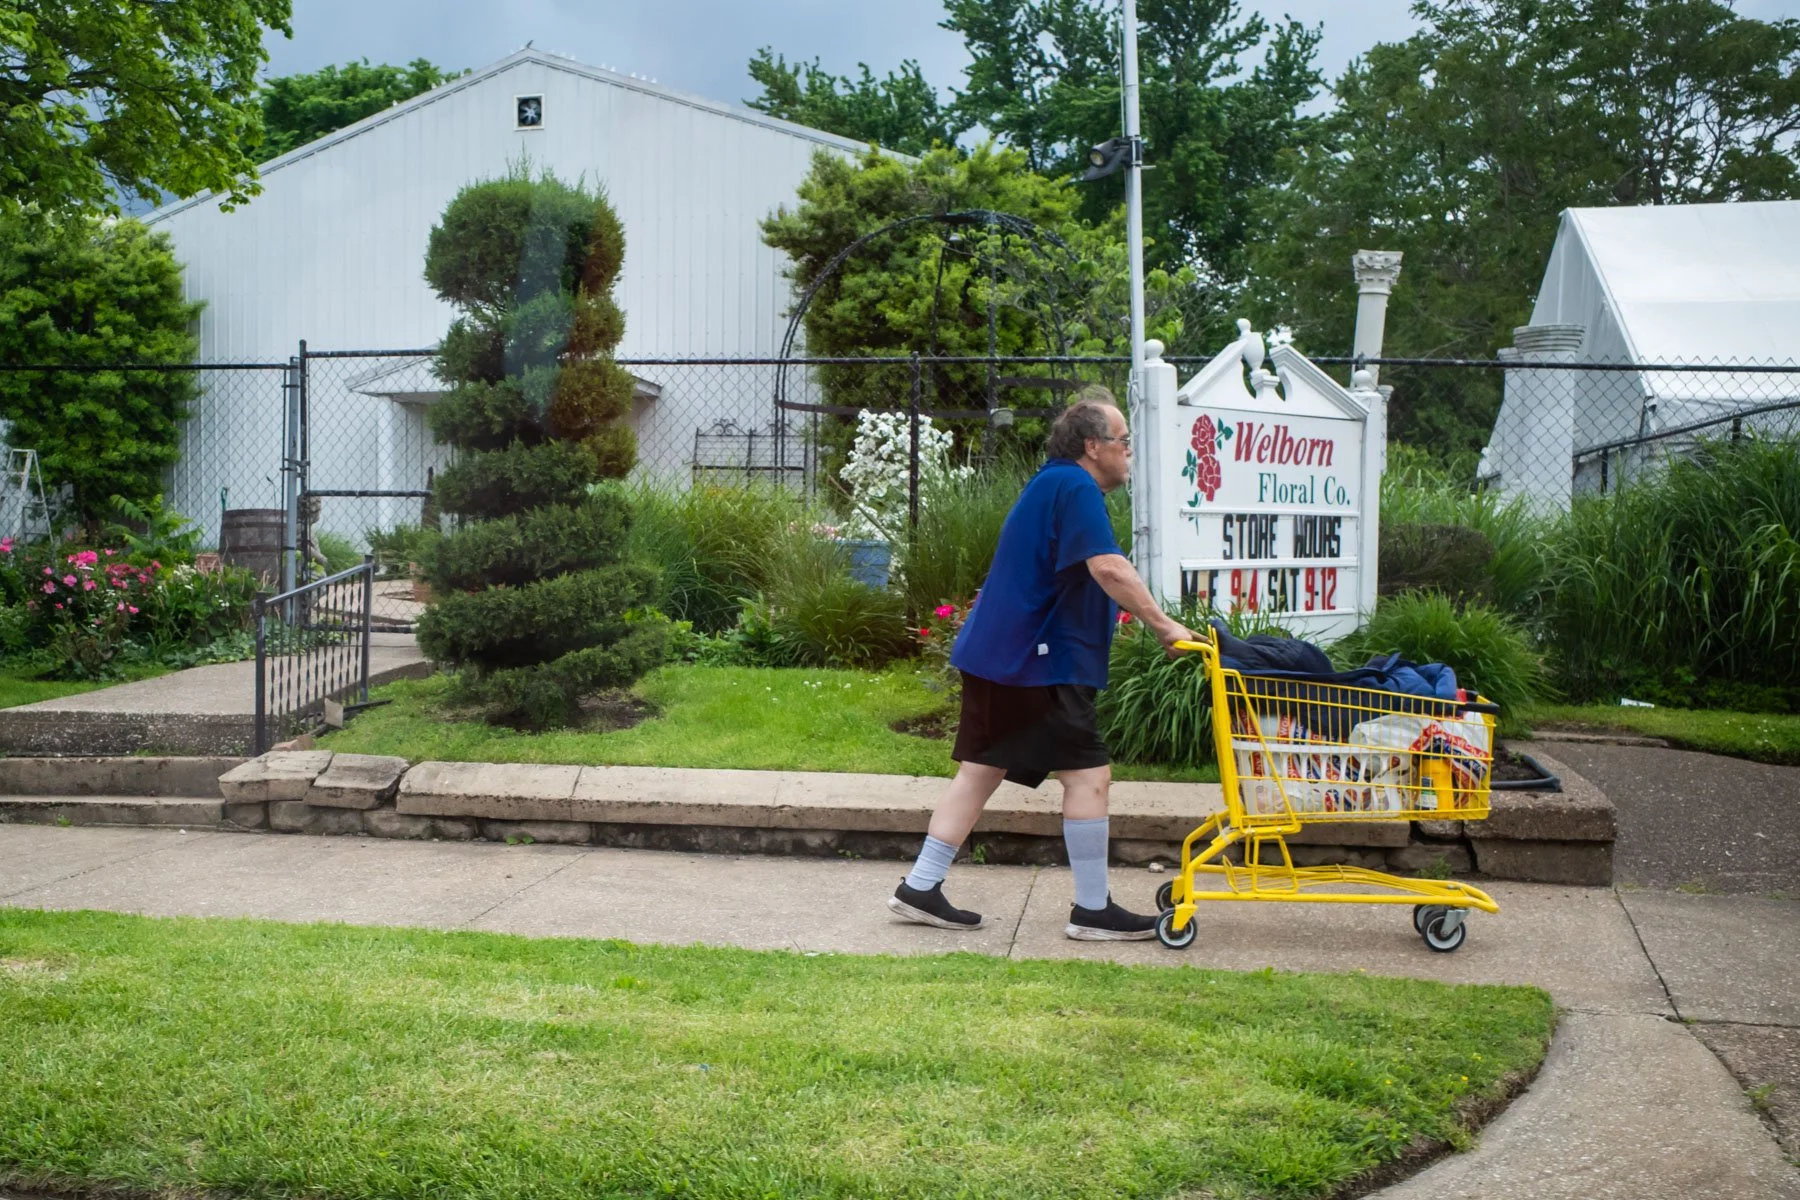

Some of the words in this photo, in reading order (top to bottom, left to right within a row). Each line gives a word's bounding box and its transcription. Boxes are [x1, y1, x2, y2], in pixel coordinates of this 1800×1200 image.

[1234, 421, 1334, 467] Welborn
[1258, 472, 1315, 505] Floral
[1324, 475, 1351, 506] Co.
[1222, 513, 1279, 560] STORE
[1230, 568, 1259, 614] 9-4
[1267, 568, 1300, 612] SAT
[1304, 566, 1337, 610] 9-12
